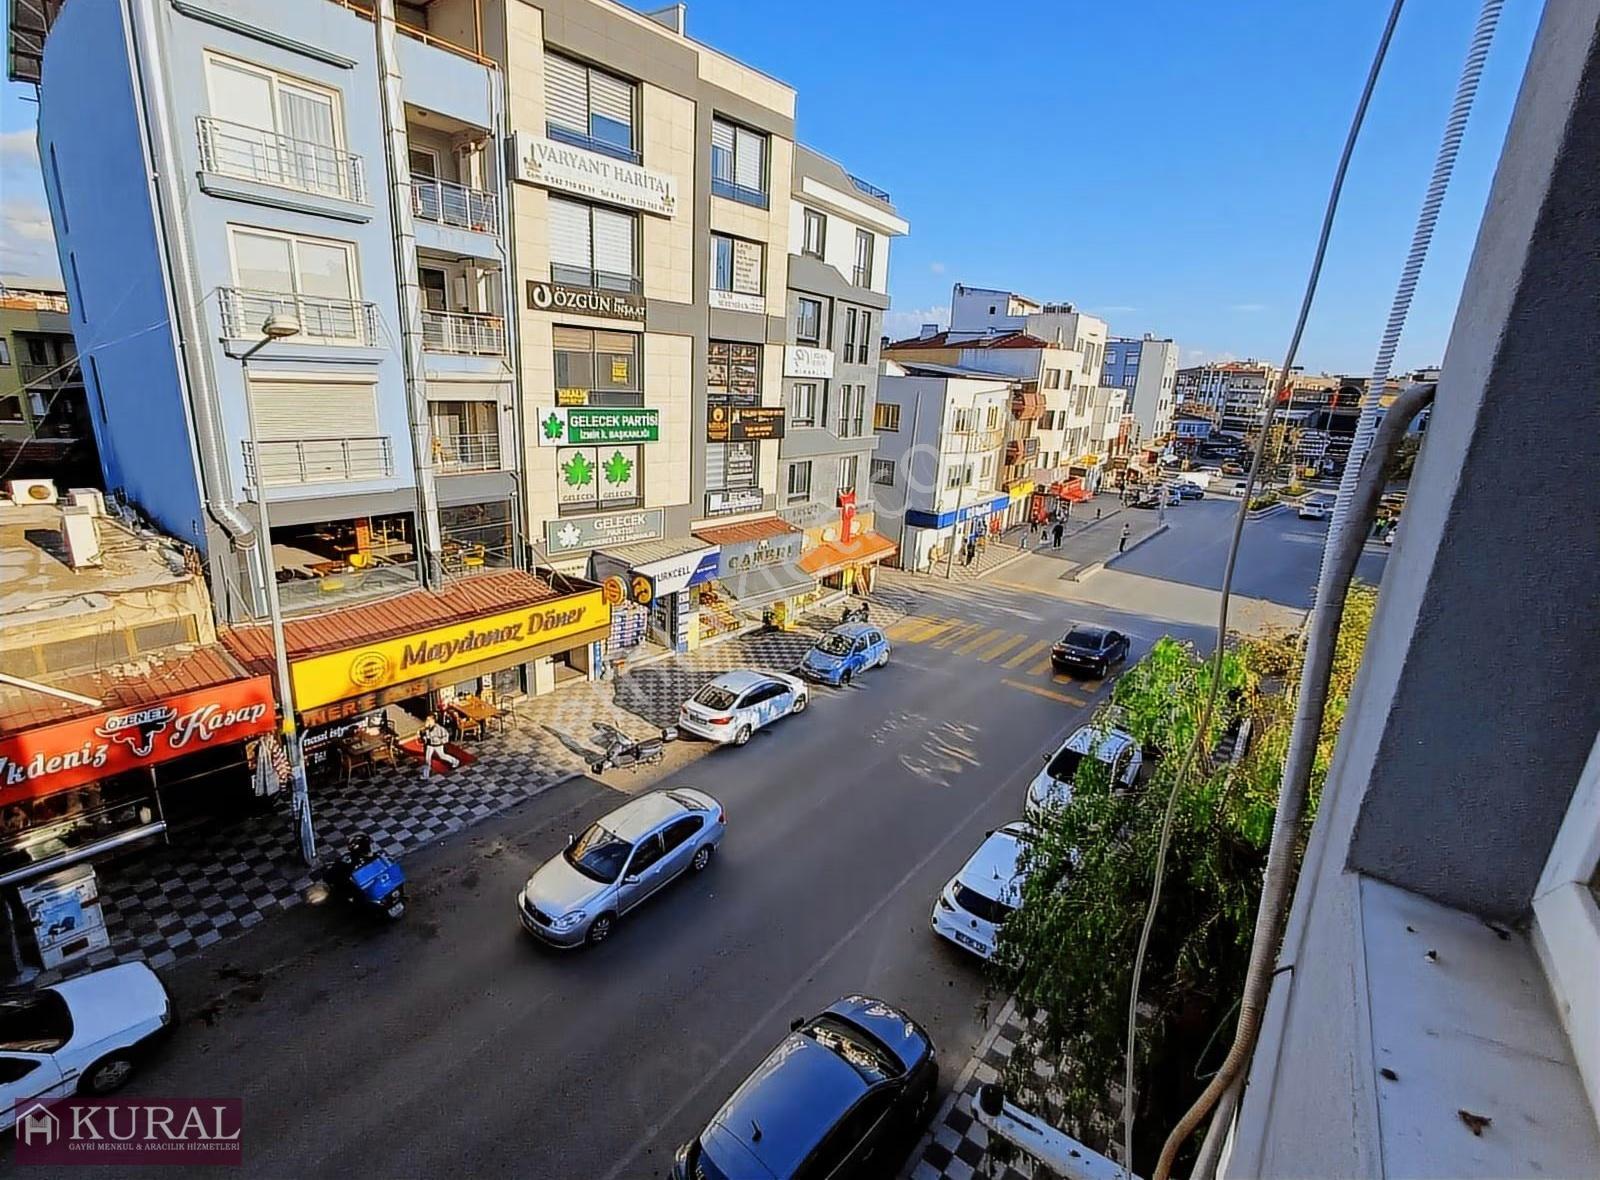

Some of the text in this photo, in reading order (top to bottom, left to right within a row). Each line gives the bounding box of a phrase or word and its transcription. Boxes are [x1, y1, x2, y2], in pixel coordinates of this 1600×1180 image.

[536, 144, 610, 179] VARYANT
[614, 169, 665, 193] HARİTA
[554, 286, 611, 312] ÖZGÜN
[570, 411, 659, 428] GELECEK PARTİSİ
[594, 513, 647, 530] GELECEK
[402, 620, 525, 669] Maydonoz
[526, 606, 587, 636] Döner
[169, 703, 267, 749] Kasap
